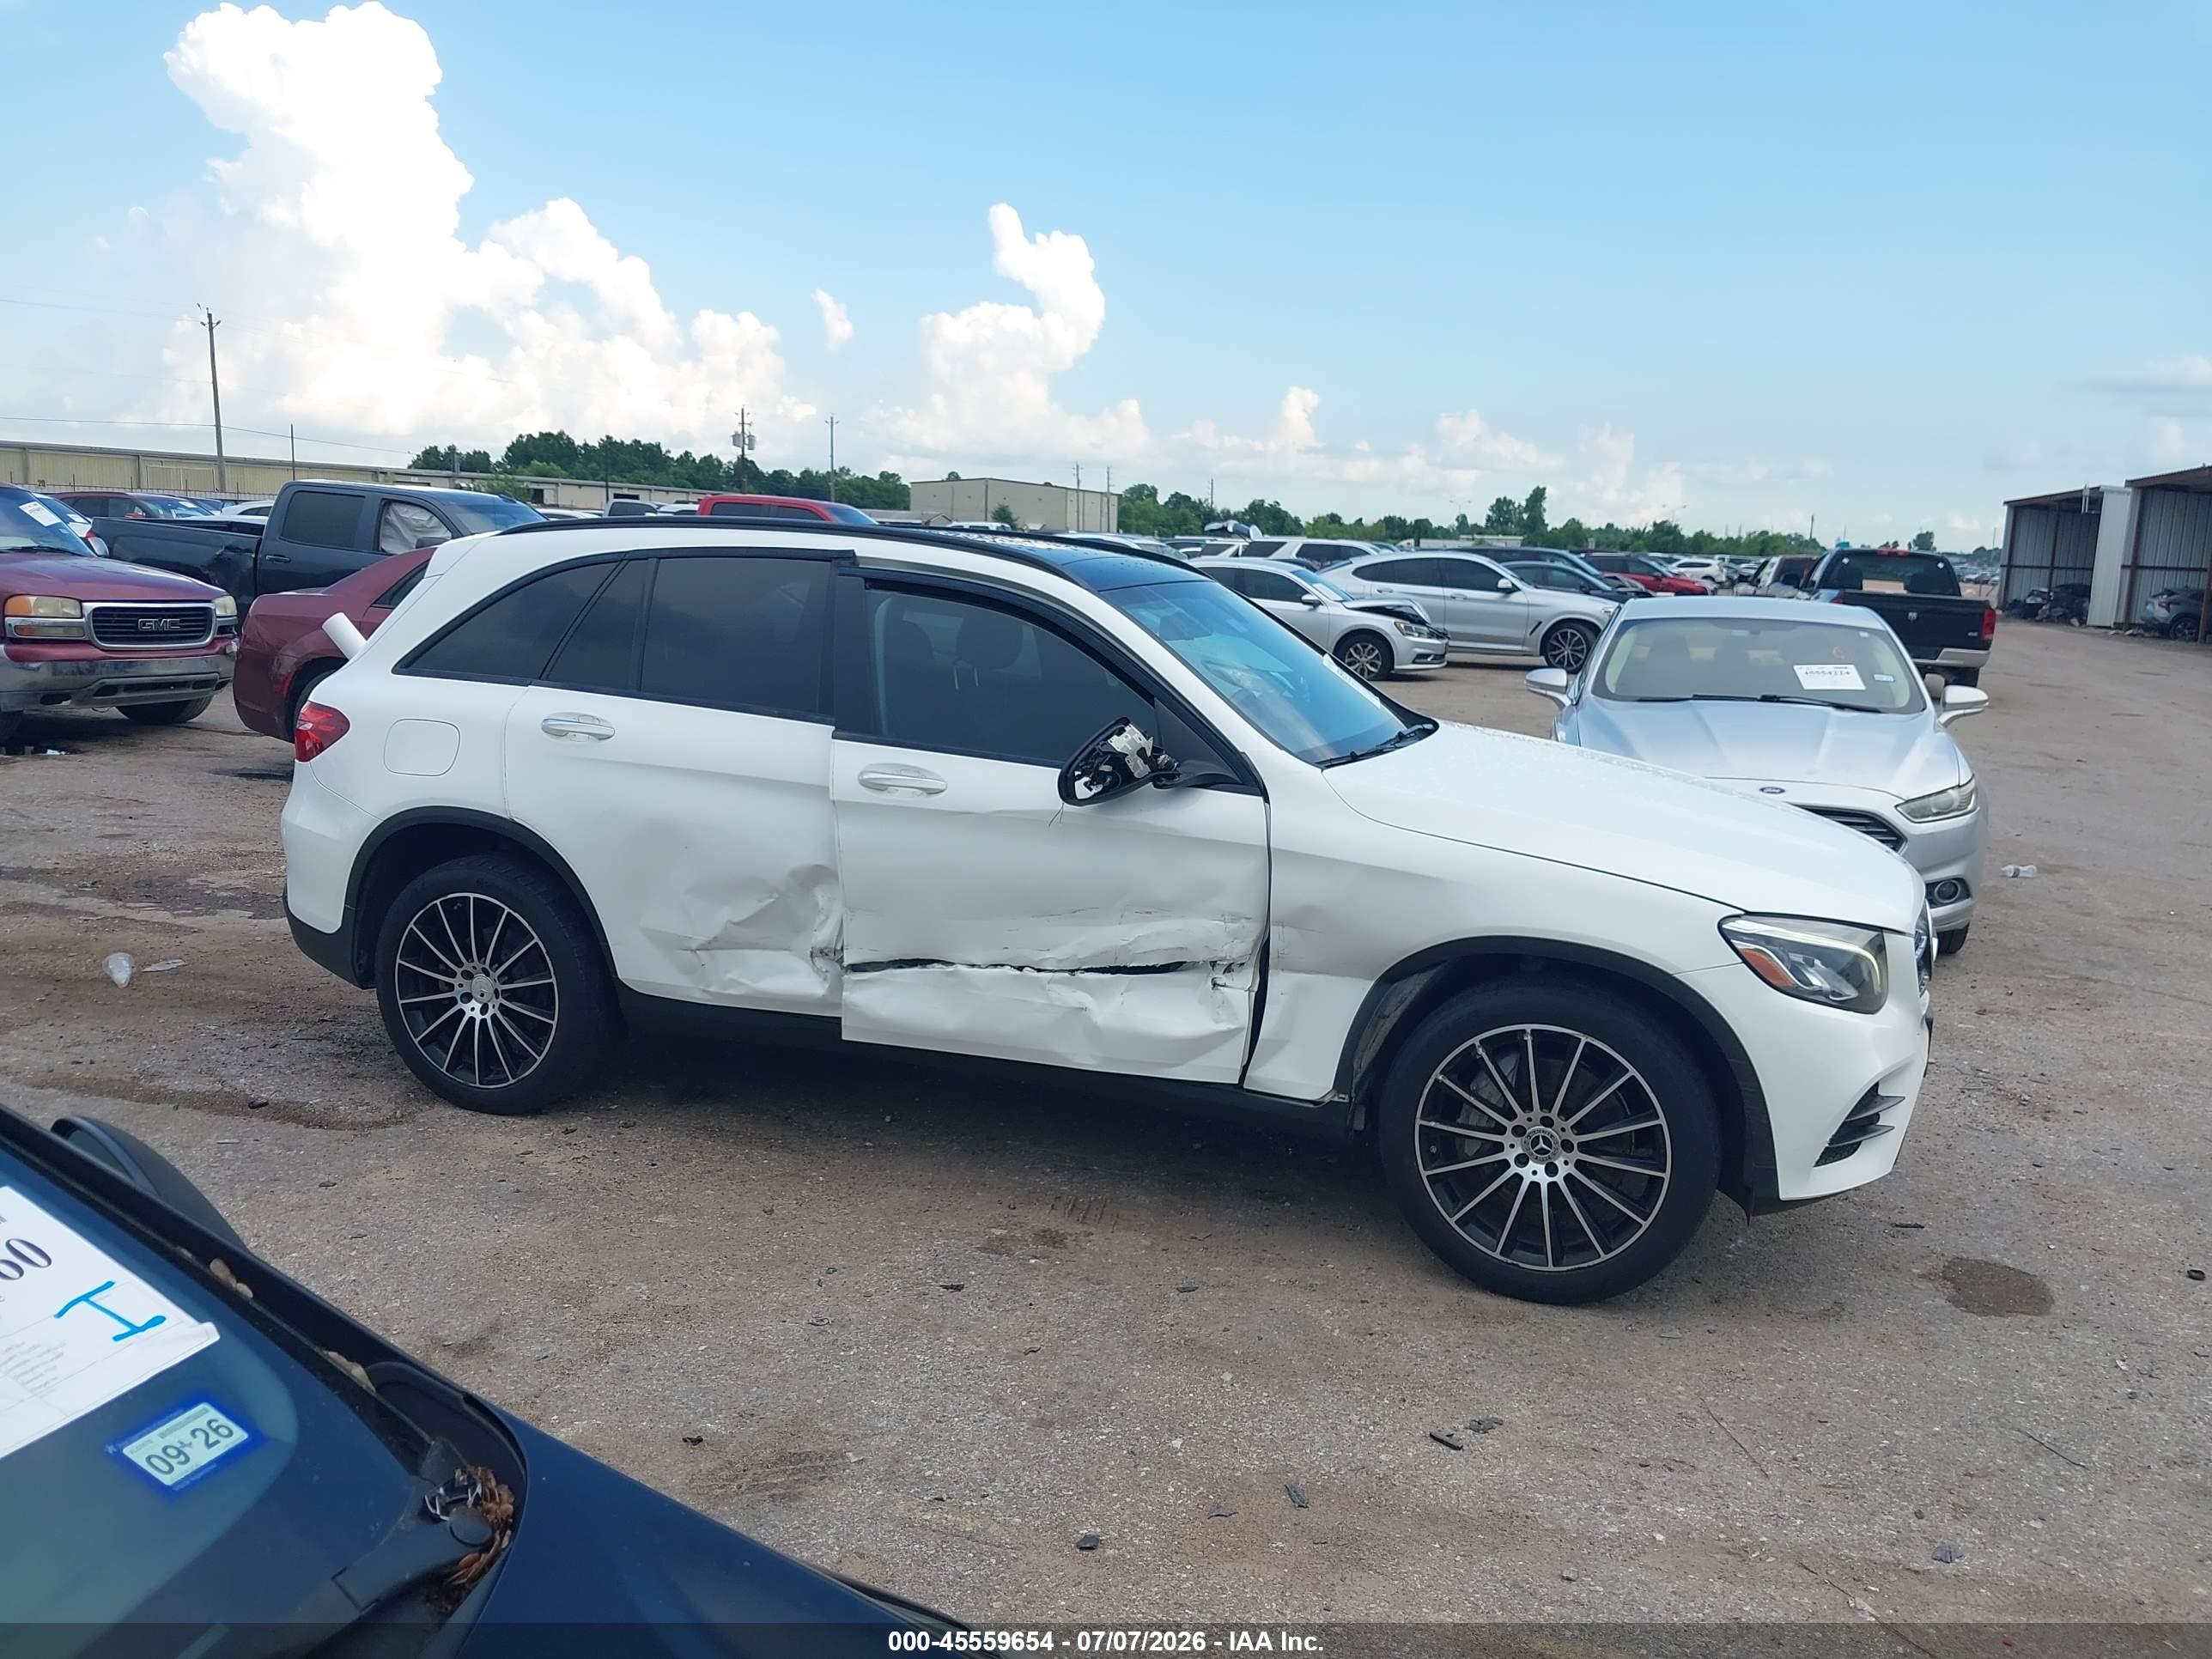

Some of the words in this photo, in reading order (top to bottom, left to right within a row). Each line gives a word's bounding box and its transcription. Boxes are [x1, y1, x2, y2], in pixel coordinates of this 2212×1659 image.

[138, 618, 180, 631] GMC
[145, 1444, 191, 1475] 09
[191, 1419, 234, 1449] 26
